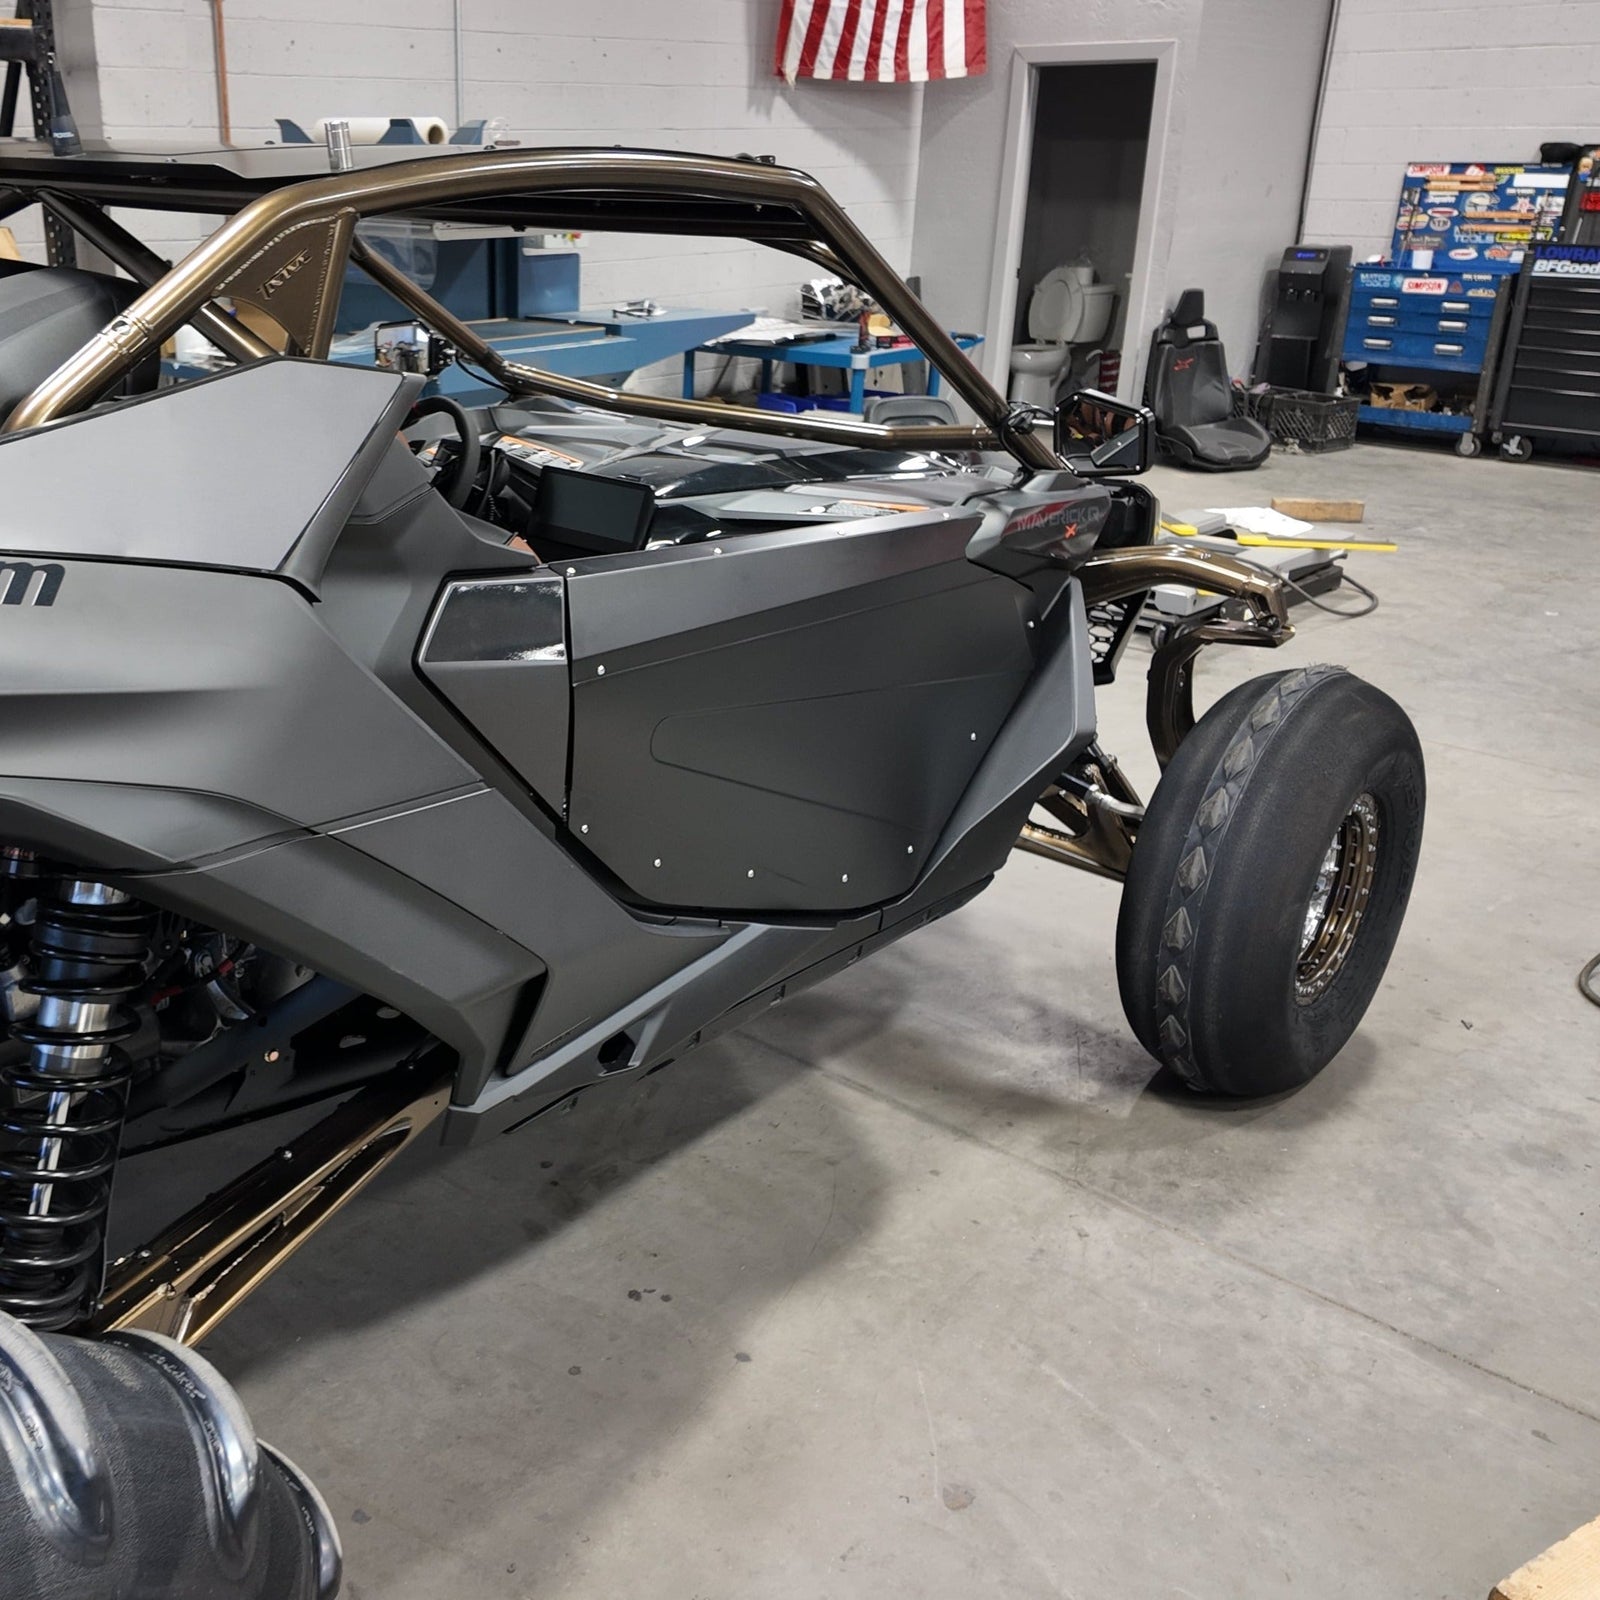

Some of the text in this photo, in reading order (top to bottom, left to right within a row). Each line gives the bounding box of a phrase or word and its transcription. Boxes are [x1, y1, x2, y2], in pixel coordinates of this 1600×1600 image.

[1535, 245, 1600, 261] LOWRA
[1407, 281, 1442, 291] SIMPSON
[1017, 507, 1087, 531] MAVERICK
